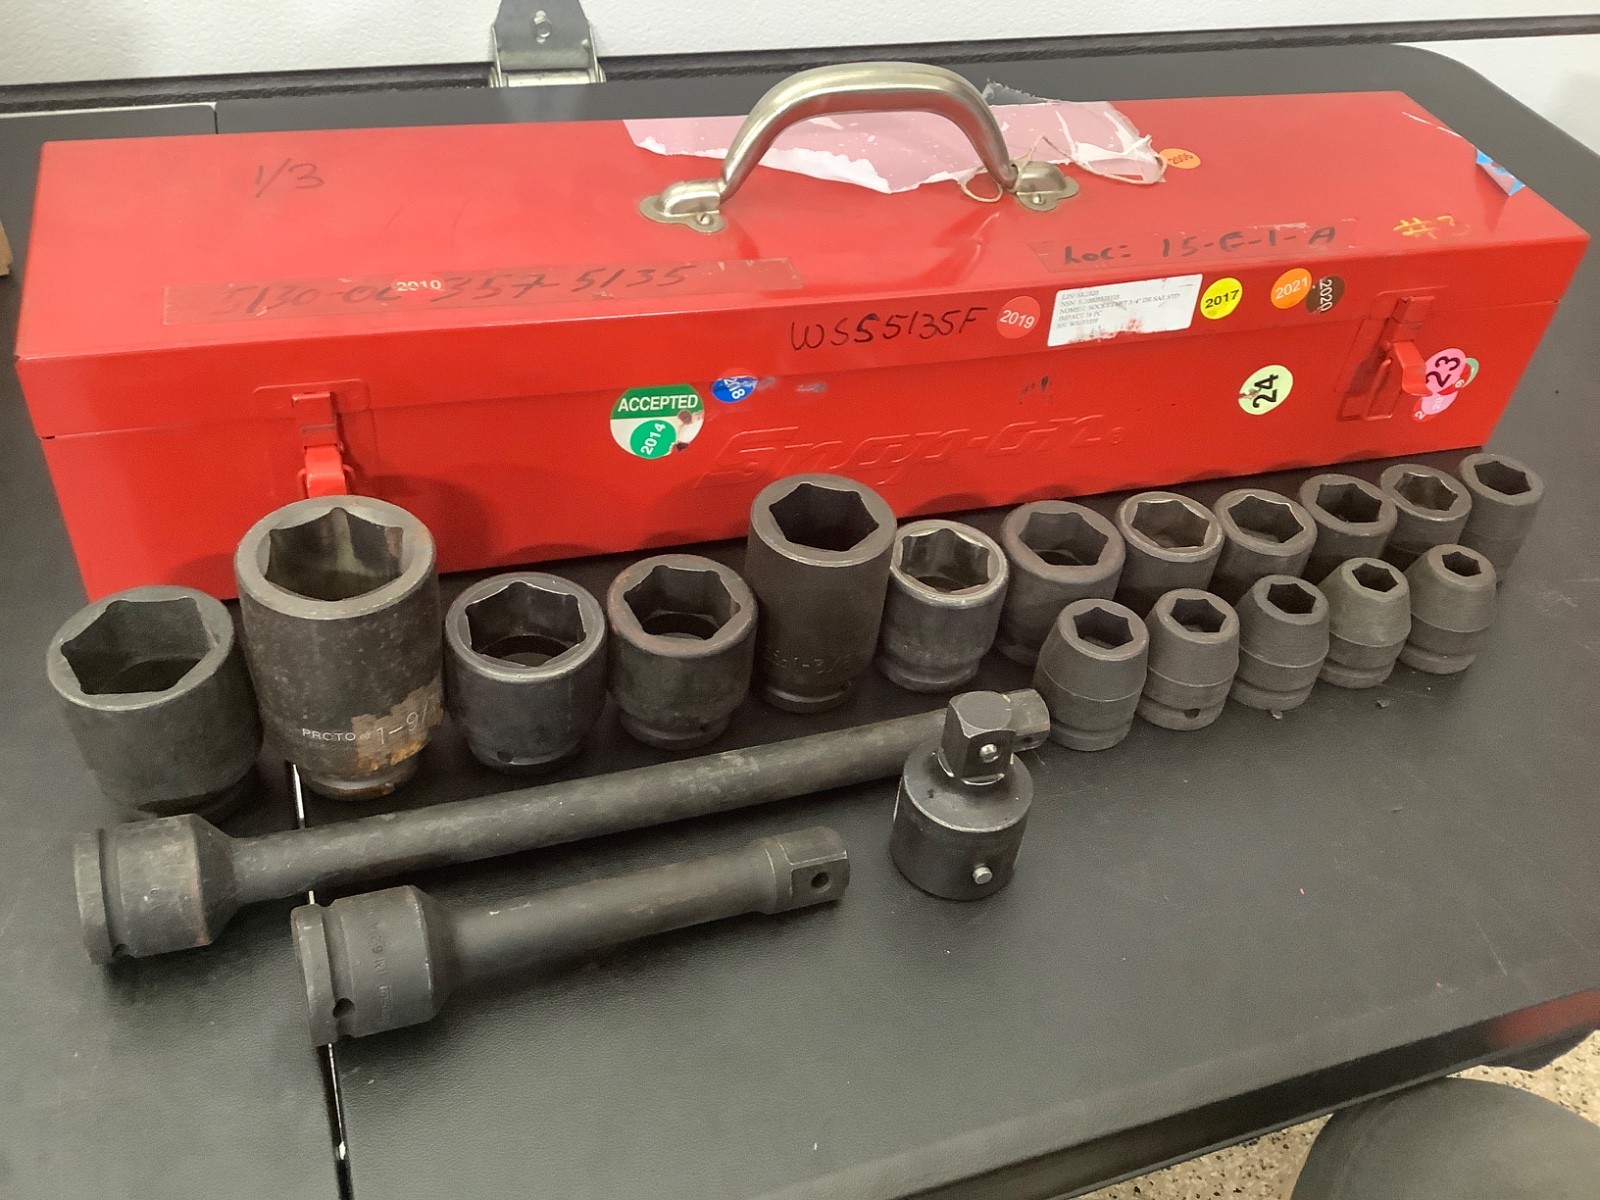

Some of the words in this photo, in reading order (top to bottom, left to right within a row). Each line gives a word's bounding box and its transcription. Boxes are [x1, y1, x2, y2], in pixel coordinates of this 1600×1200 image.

[255, 157, 325, 198] 1/3
[396, 279, 443, 292] 2010
[1274, 276, 1308, 300] 2021
[1318, 279, 1333, 312] 2020
[1204, 290, 1240, 309] 2017
[1000, 309, 1036, 329] 2019
[1425, 356, 1461, 388] 23
[617, 394, 699, 412] ACCEPTED
[1252, 374, 1279, 408] 24
[640, 422, 667, 456] 2014
[302, 728, 356, 741] PROTO
